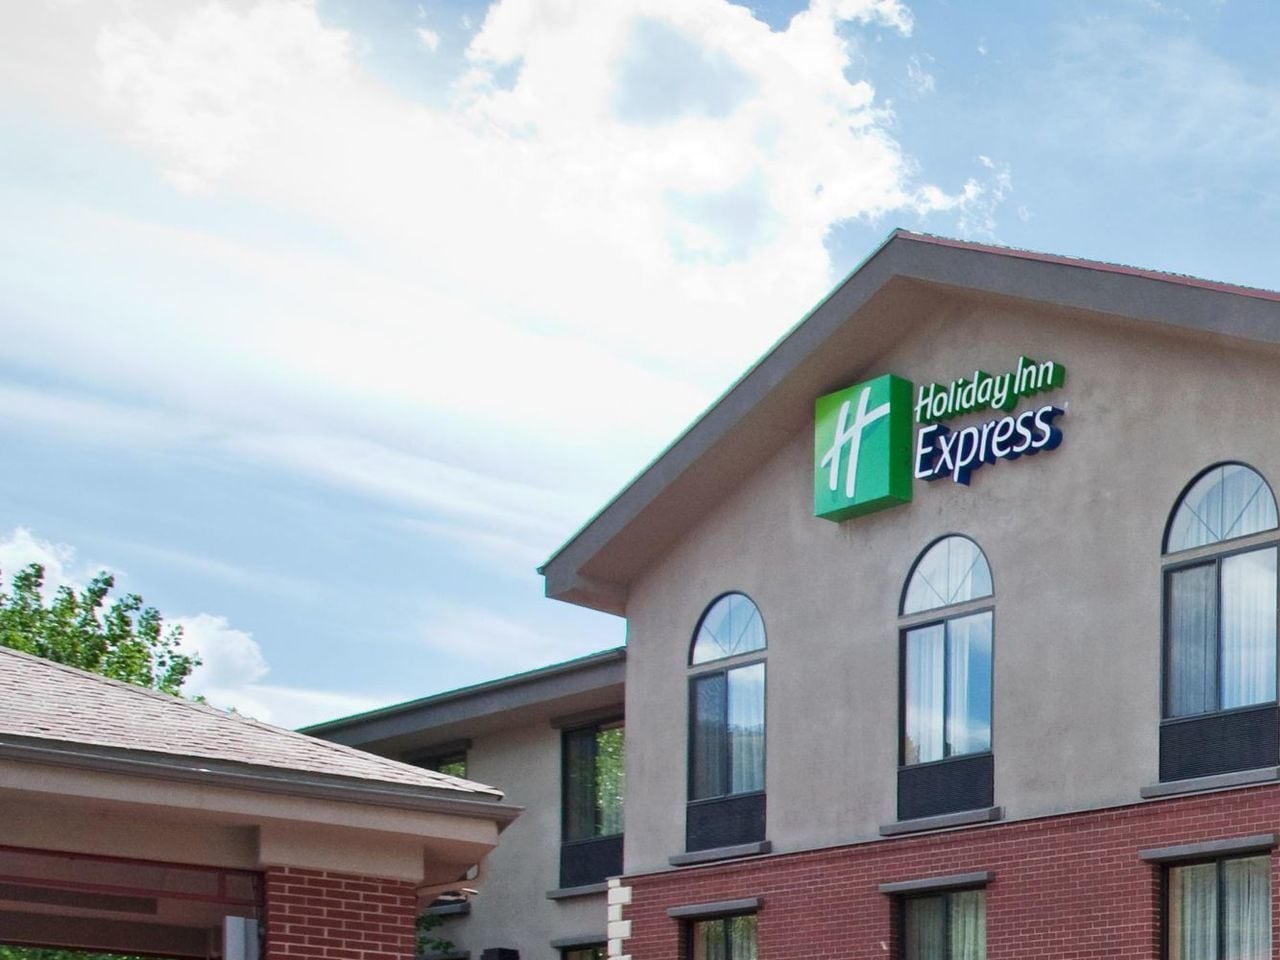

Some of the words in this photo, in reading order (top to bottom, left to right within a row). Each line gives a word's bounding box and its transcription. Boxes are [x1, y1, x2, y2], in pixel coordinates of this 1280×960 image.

[914, 370, 1011, 422] Holiday
[1013, 356, 1054, 394] Inn
[914, 405, 1053, 482] Express
